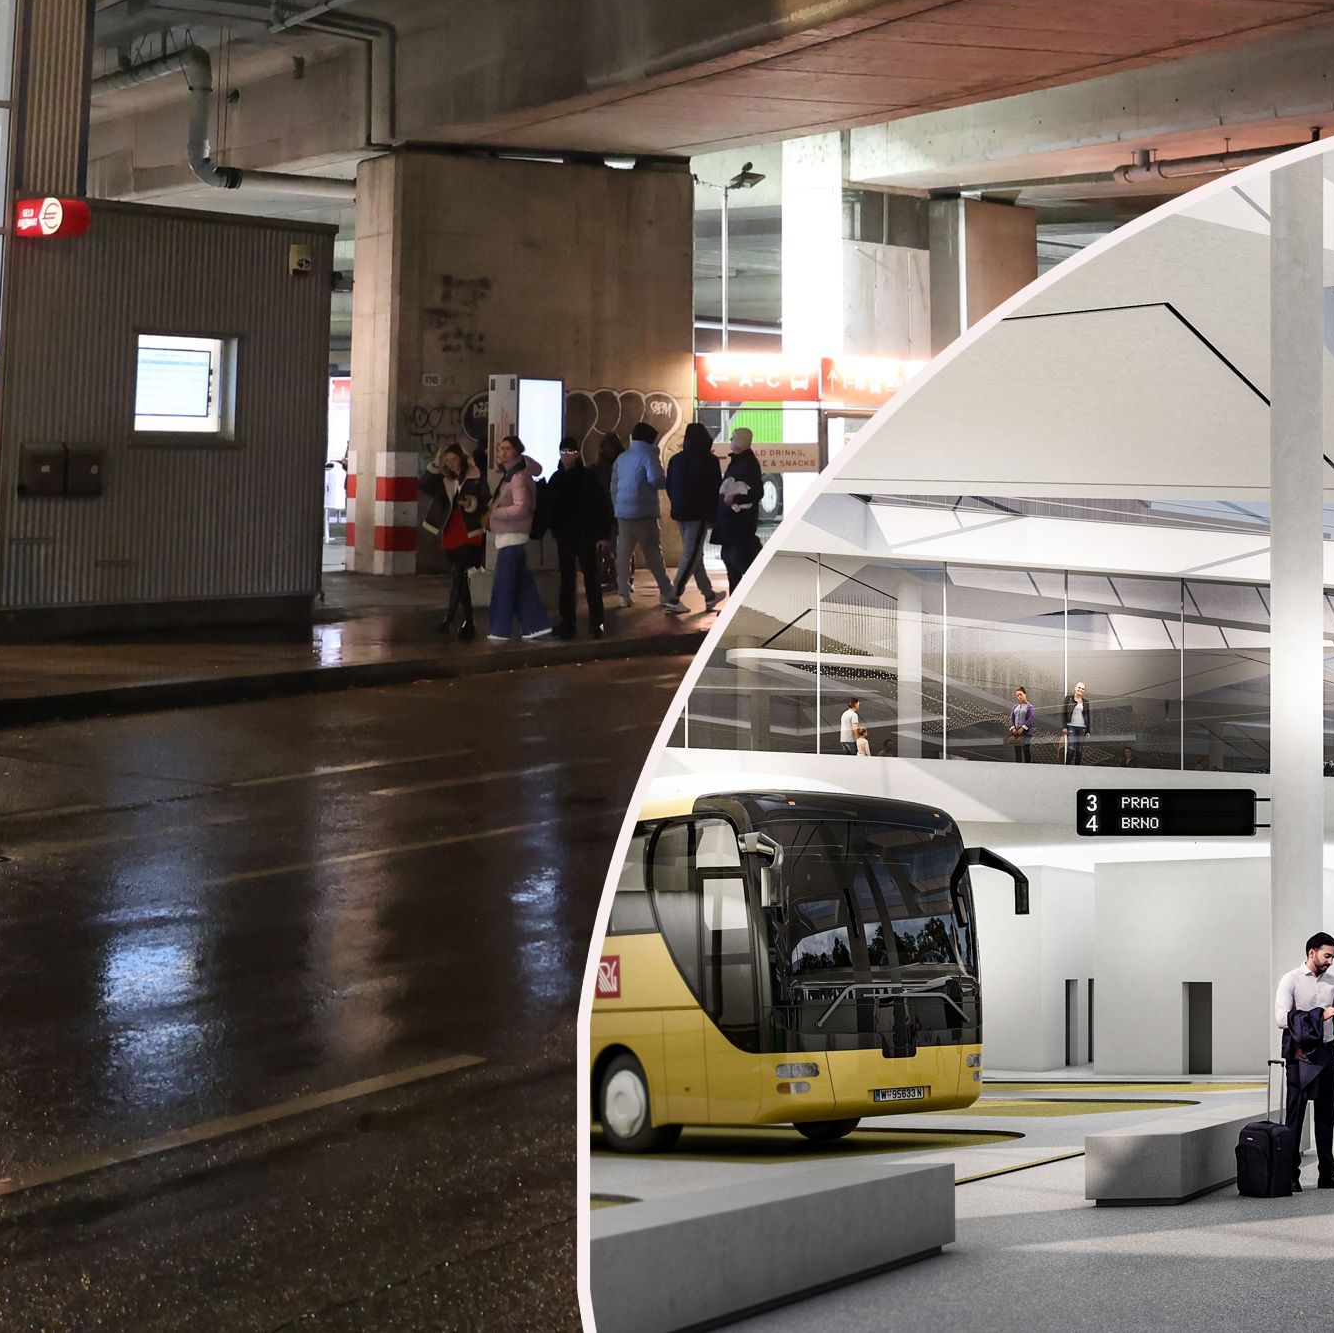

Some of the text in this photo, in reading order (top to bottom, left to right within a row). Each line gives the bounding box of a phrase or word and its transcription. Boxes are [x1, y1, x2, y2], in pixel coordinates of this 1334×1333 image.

[755, 449, 806, 458] LD DRINKS,
[1086, 794, 1159, 811] 3 PRAG
[1085, 815, 1159, 832] 4 BRNO
